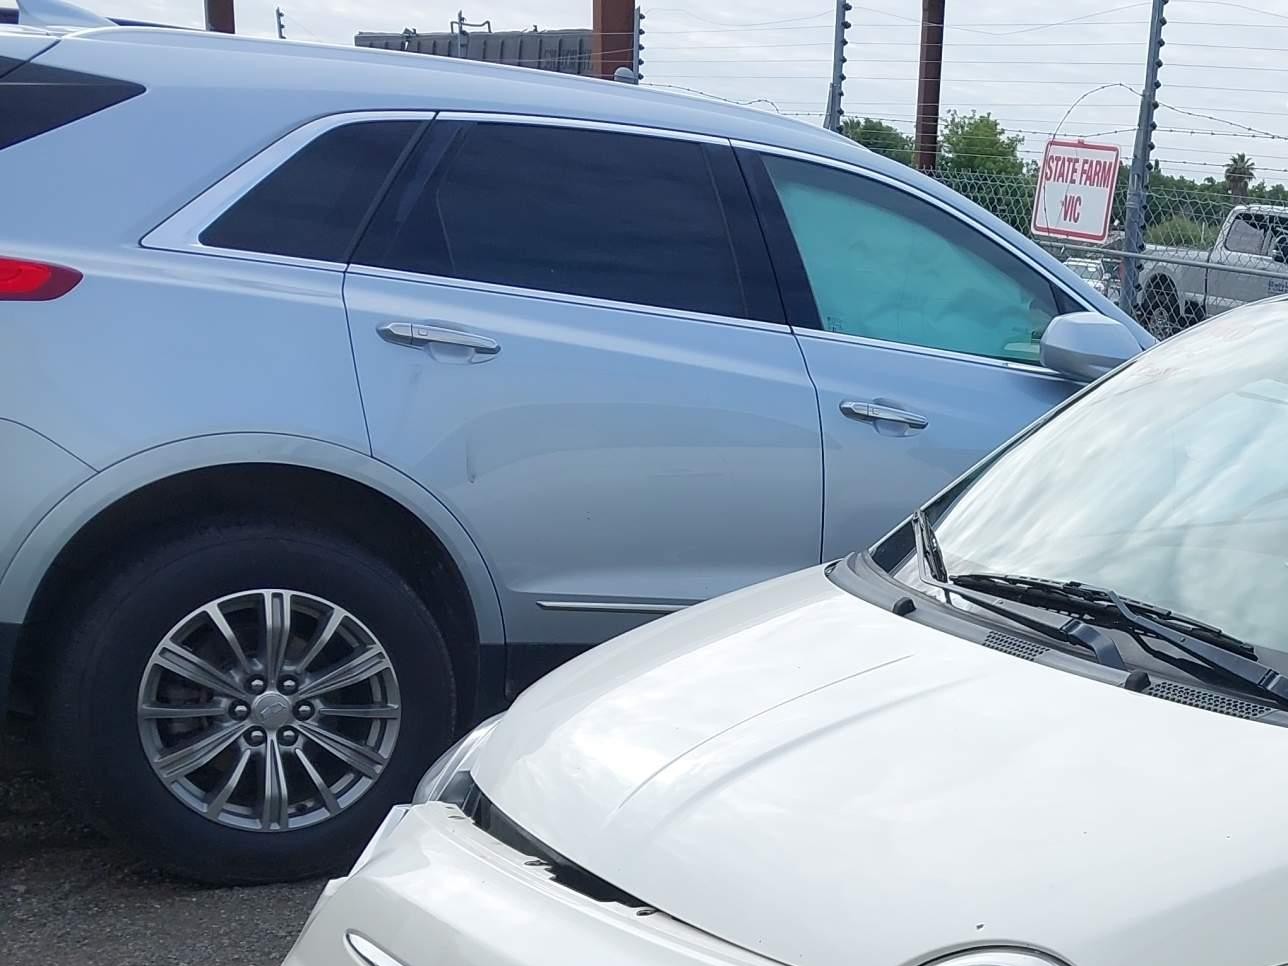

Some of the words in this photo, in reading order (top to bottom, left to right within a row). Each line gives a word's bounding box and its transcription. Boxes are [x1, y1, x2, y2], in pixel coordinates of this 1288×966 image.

[1045, 155, 1079, 185] STATE
[1079, 159, 1113, 189] FARM
[1063, 194, 1082, 223] VIC
